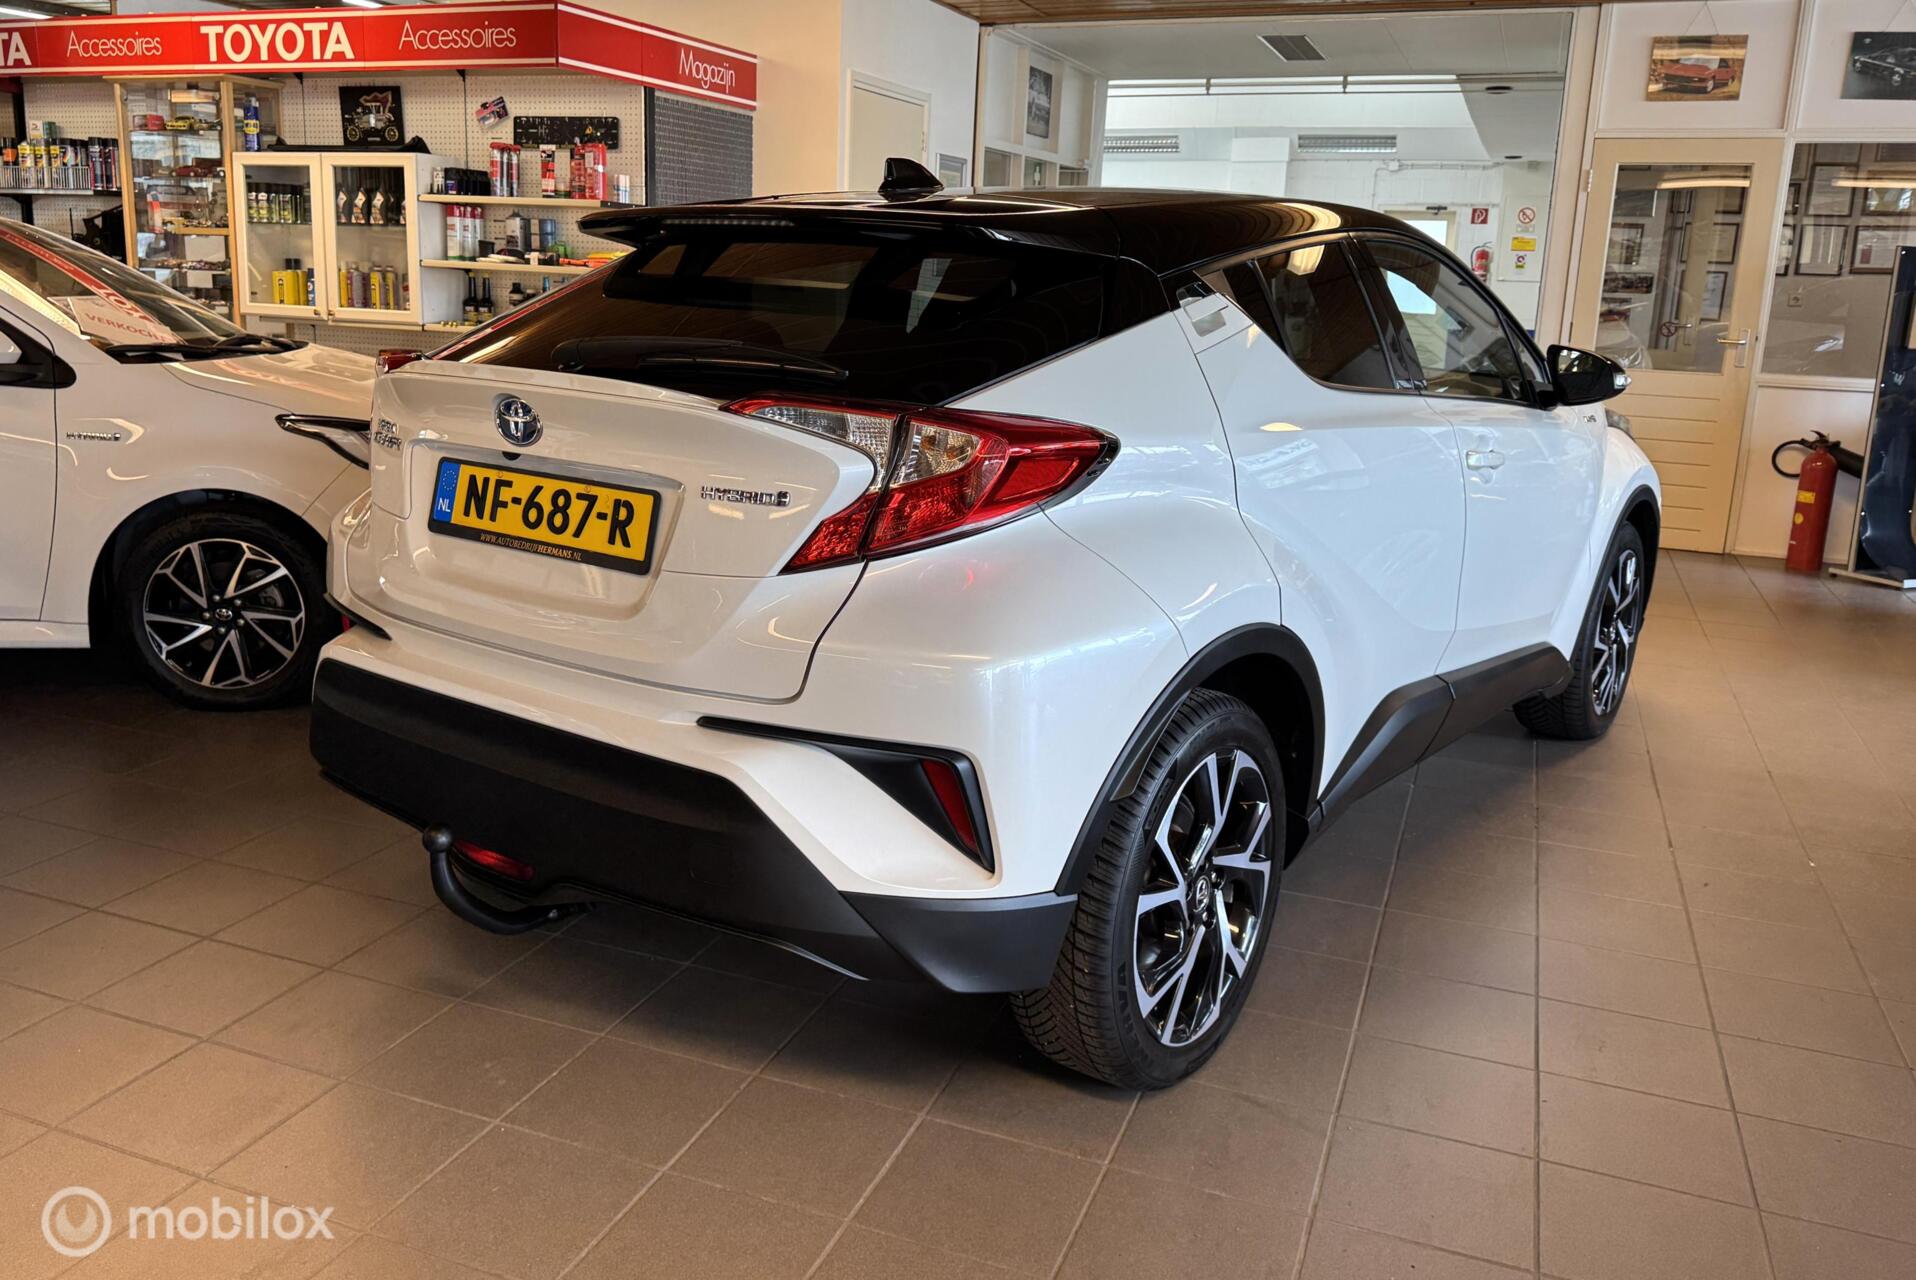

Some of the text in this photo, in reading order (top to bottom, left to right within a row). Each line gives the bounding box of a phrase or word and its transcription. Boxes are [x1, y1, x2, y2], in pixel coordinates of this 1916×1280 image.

[66, 31, 162, 58] Accessoires
[199, 22, 356, 62] TOYOTA
[398, 20, 517, 50] Accessoires
[678, 47, 736, 94] Magazijn
[437, 498, 451, 513] NL
[701, 485, 777, 506] HYBRID
[463, 473, 635, 548] NF-687-R
[479, 532, 583, 561] WWW.AUTOBEDRIJFHERMANS.NL
